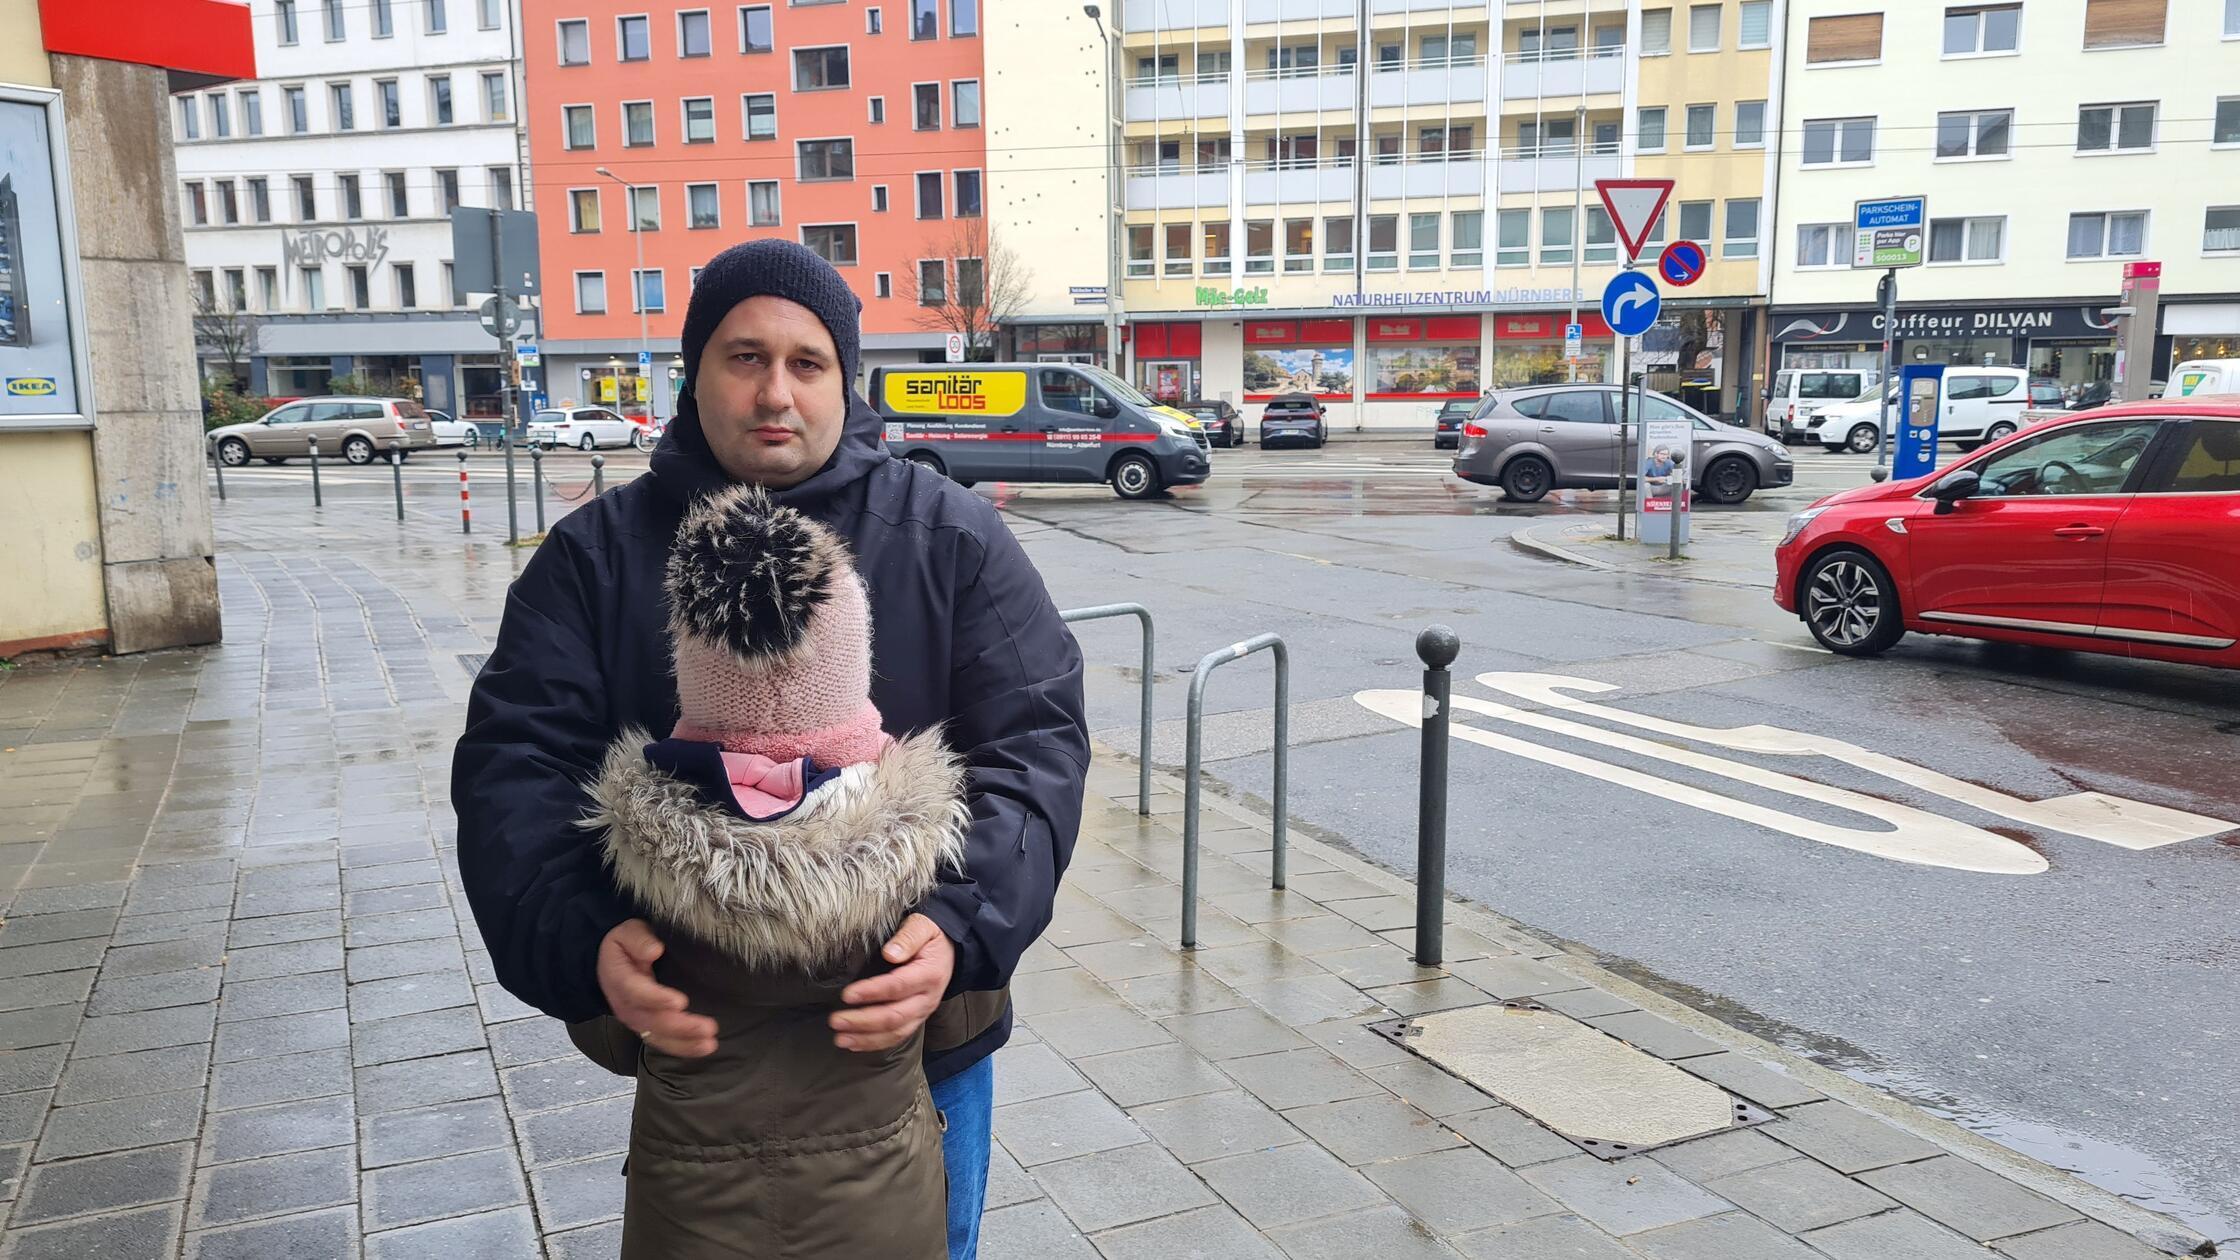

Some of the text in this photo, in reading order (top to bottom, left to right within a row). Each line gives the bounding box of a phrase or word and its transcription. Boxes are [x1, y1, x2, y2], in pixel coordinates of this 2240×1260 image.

[1861, 203, 1918, 214] PARKSCHEIN-
[1869, 214, 1909, 225] AUTOMAT
[1332, 287, 1583, 306] NATURHEILZENTRUM NÜRNBERG
[1872, 312, 2052, 329] Coiffeur DILVAN
[906, 375, 982, 394] sanitär
[938, 390, 986, 410] Loos
